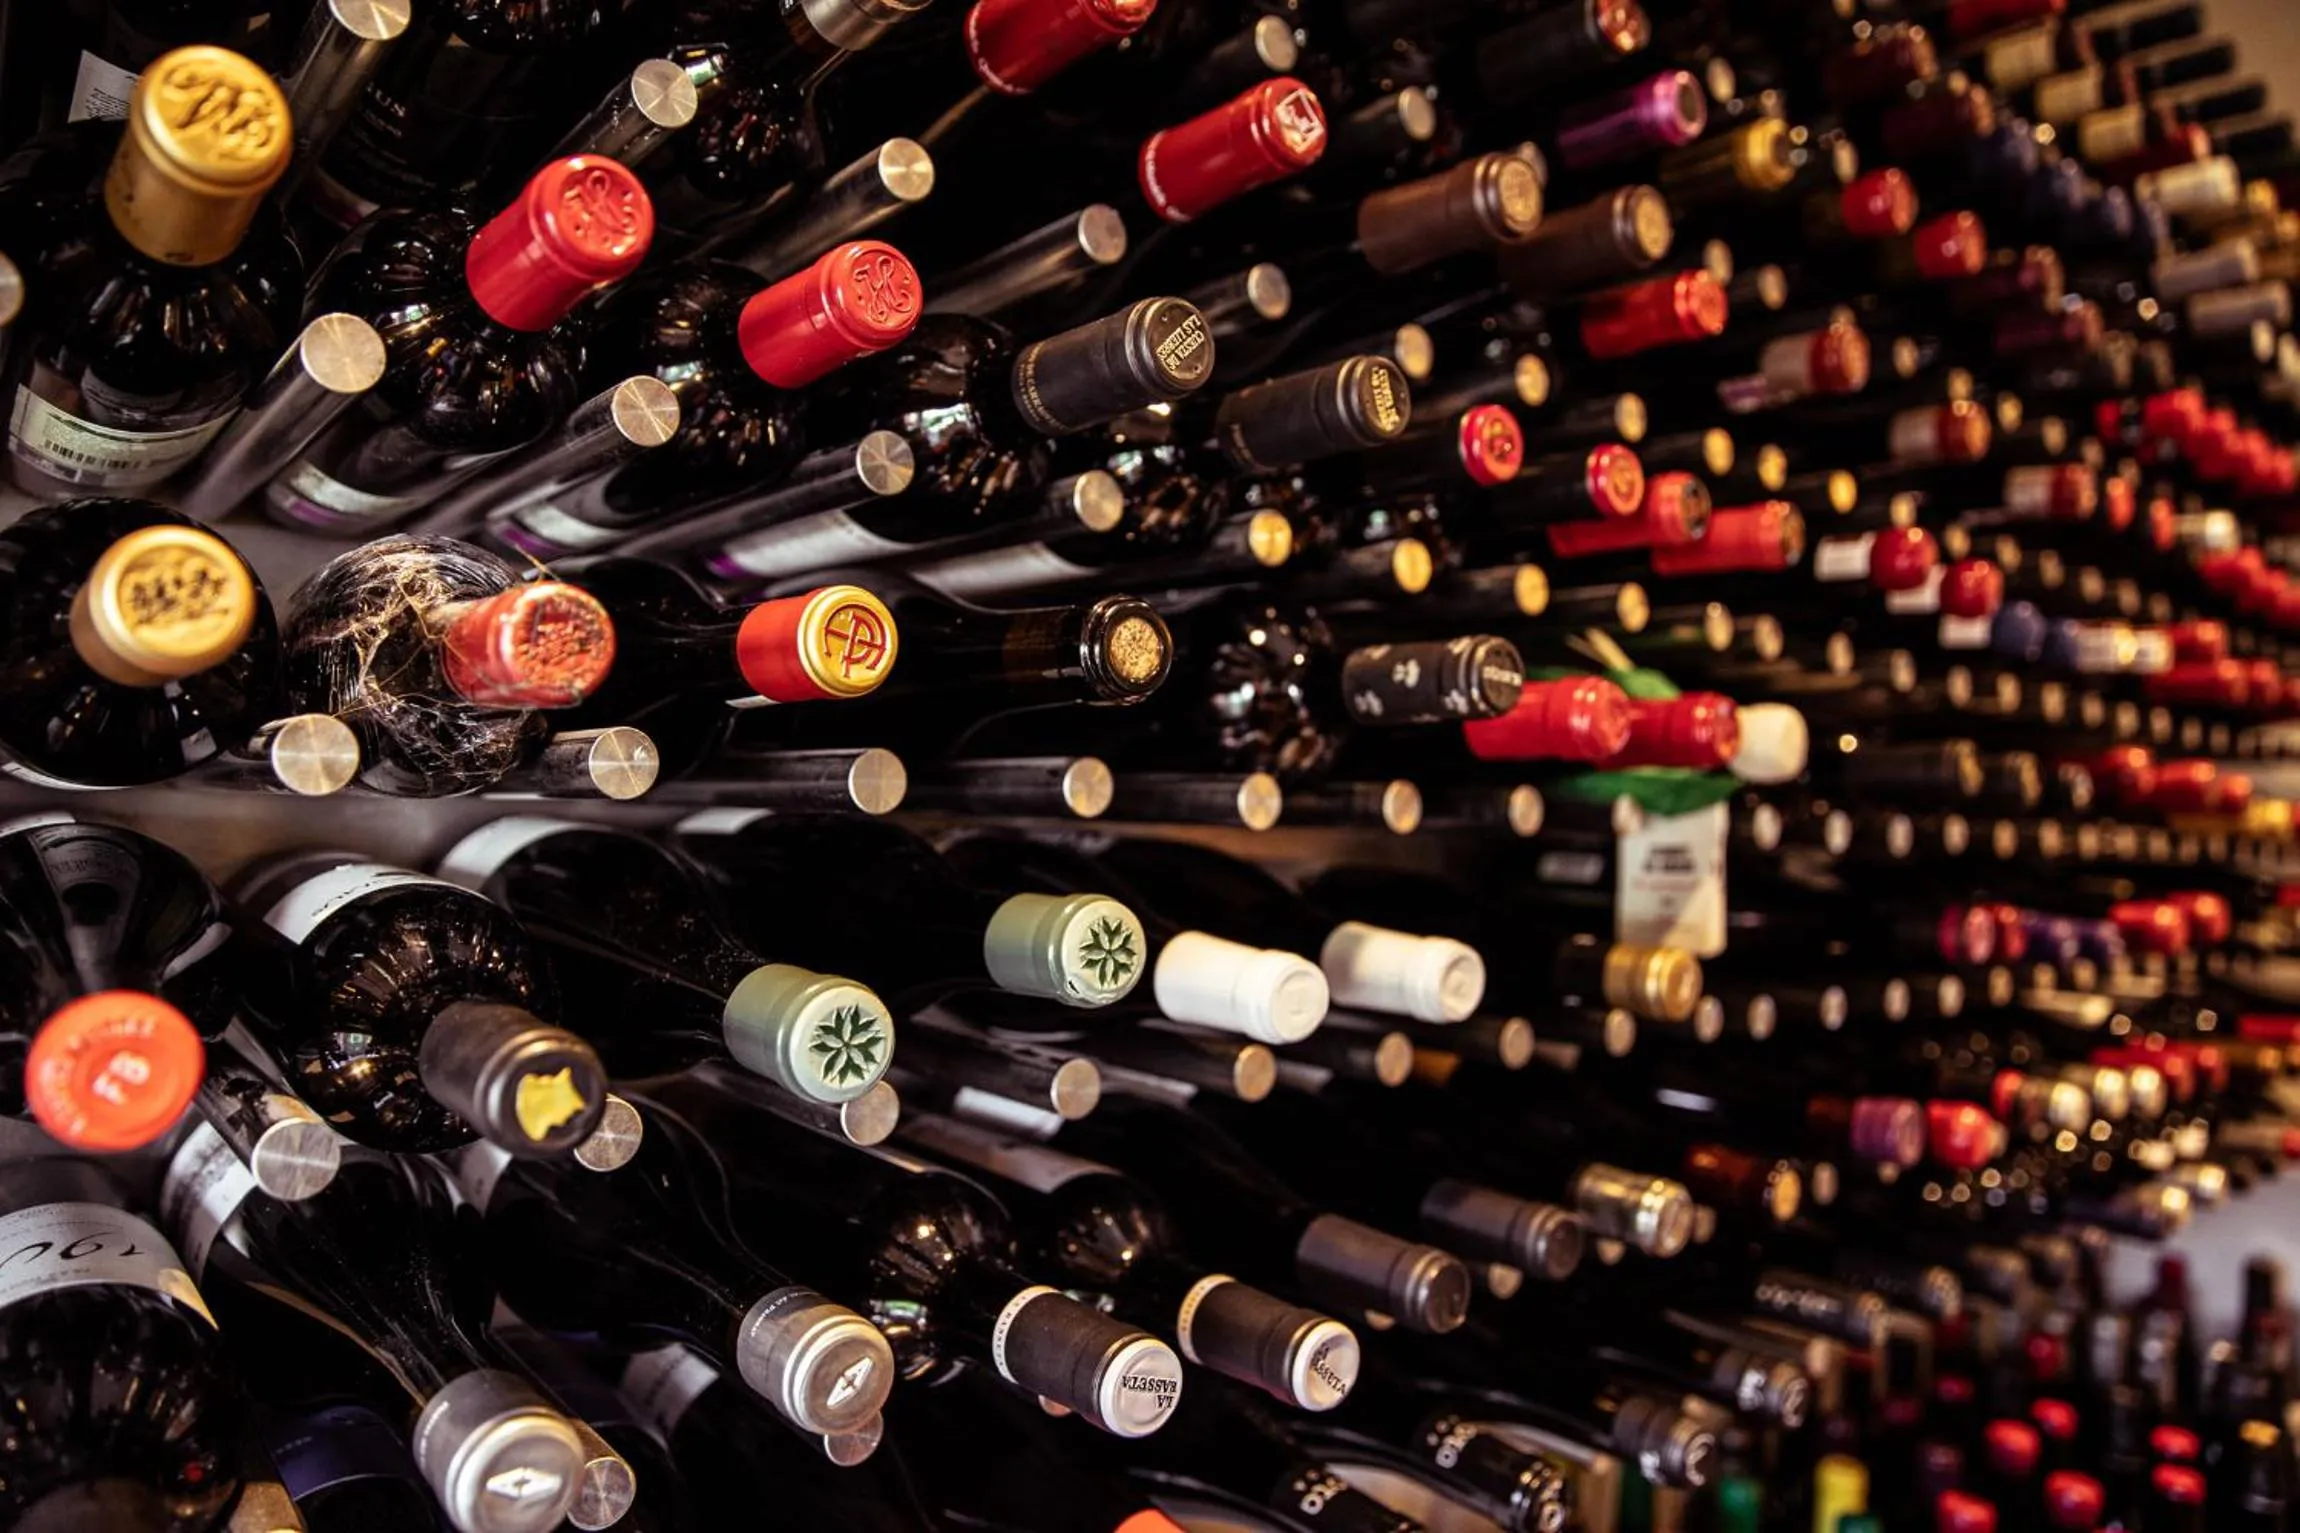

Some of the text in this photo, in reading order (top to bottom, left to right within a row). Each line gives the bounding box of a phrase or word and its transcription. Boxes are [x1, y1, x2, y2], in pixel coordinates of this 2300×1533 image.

[1182, 314, 1201, 335] LAS
[1165, 330, 1205, 370] CUESTA DE
[1122, 1375, 1178, 1394] BASSETA
[1157, 1394, 1175, 1409] LA
